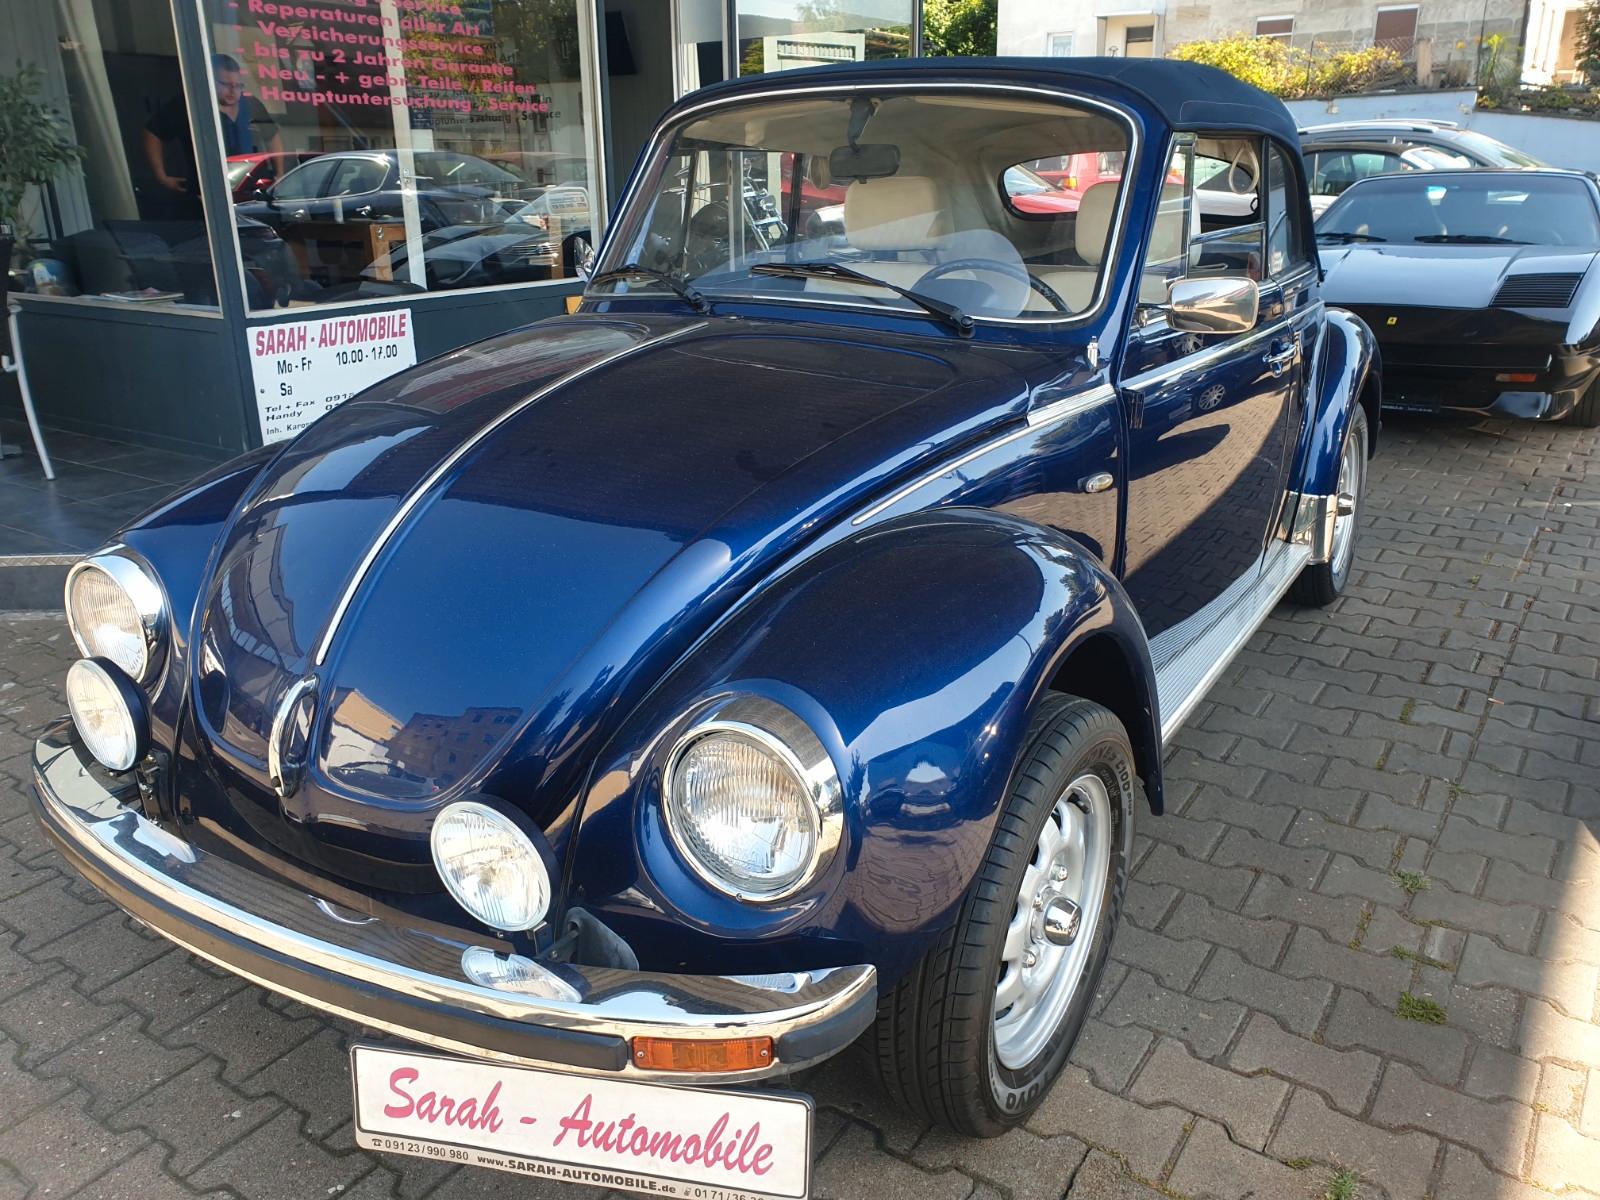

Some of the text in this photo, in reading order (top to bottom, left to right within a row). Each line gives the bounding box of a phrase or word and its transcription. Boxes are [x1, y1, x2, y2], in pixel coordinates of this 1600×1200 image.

[248, 1, 394, 28] Reperaturen
[401, 16, 446, 34] aller
[452, 21, 481, 36] Art
[257, 20, 484, 56] Versicherungsservice
[255, 41, 290, 58] bis
[297, 50, 325, 62] zu
[332, 48, 346, 63] 2
[353, 52, 426, 71] Jahren
[431, 57, 514, 76] Garantie
[258, 64, 309, 81] Neu
[358, 74, 412, 89] gebr.
[418, 75, 464, 92] Teile
[482, 78, 537, 95] Reifen
[261, 86, 472, 113] Hauptuntersuchung
[488, 97, 549, 113] Service
[255, 325, 307, 356] SARAH
[318, 313, 407, 348] AUTOMOBILE
[277, 360, 293, 375] Mo
[301, 357, 312, 372] Fr
[336, 348, 364, 366] 10.00
[371, 344, 398, 361] 17.00
[265, 405, 282, 413] Tel
[295, 399, 315, 409] Fax
[280, 382, 293, 397] Sa
[266, 410, 303, 422] Handy
[384, 1066, 503, 1133] Sarah
[553, 1094, 775, 1176] Automobile
[450, 1149, 469, 1161] 980
[477, 1155, 676, 1194] www.SARAH-AUTOMOBILE.de
